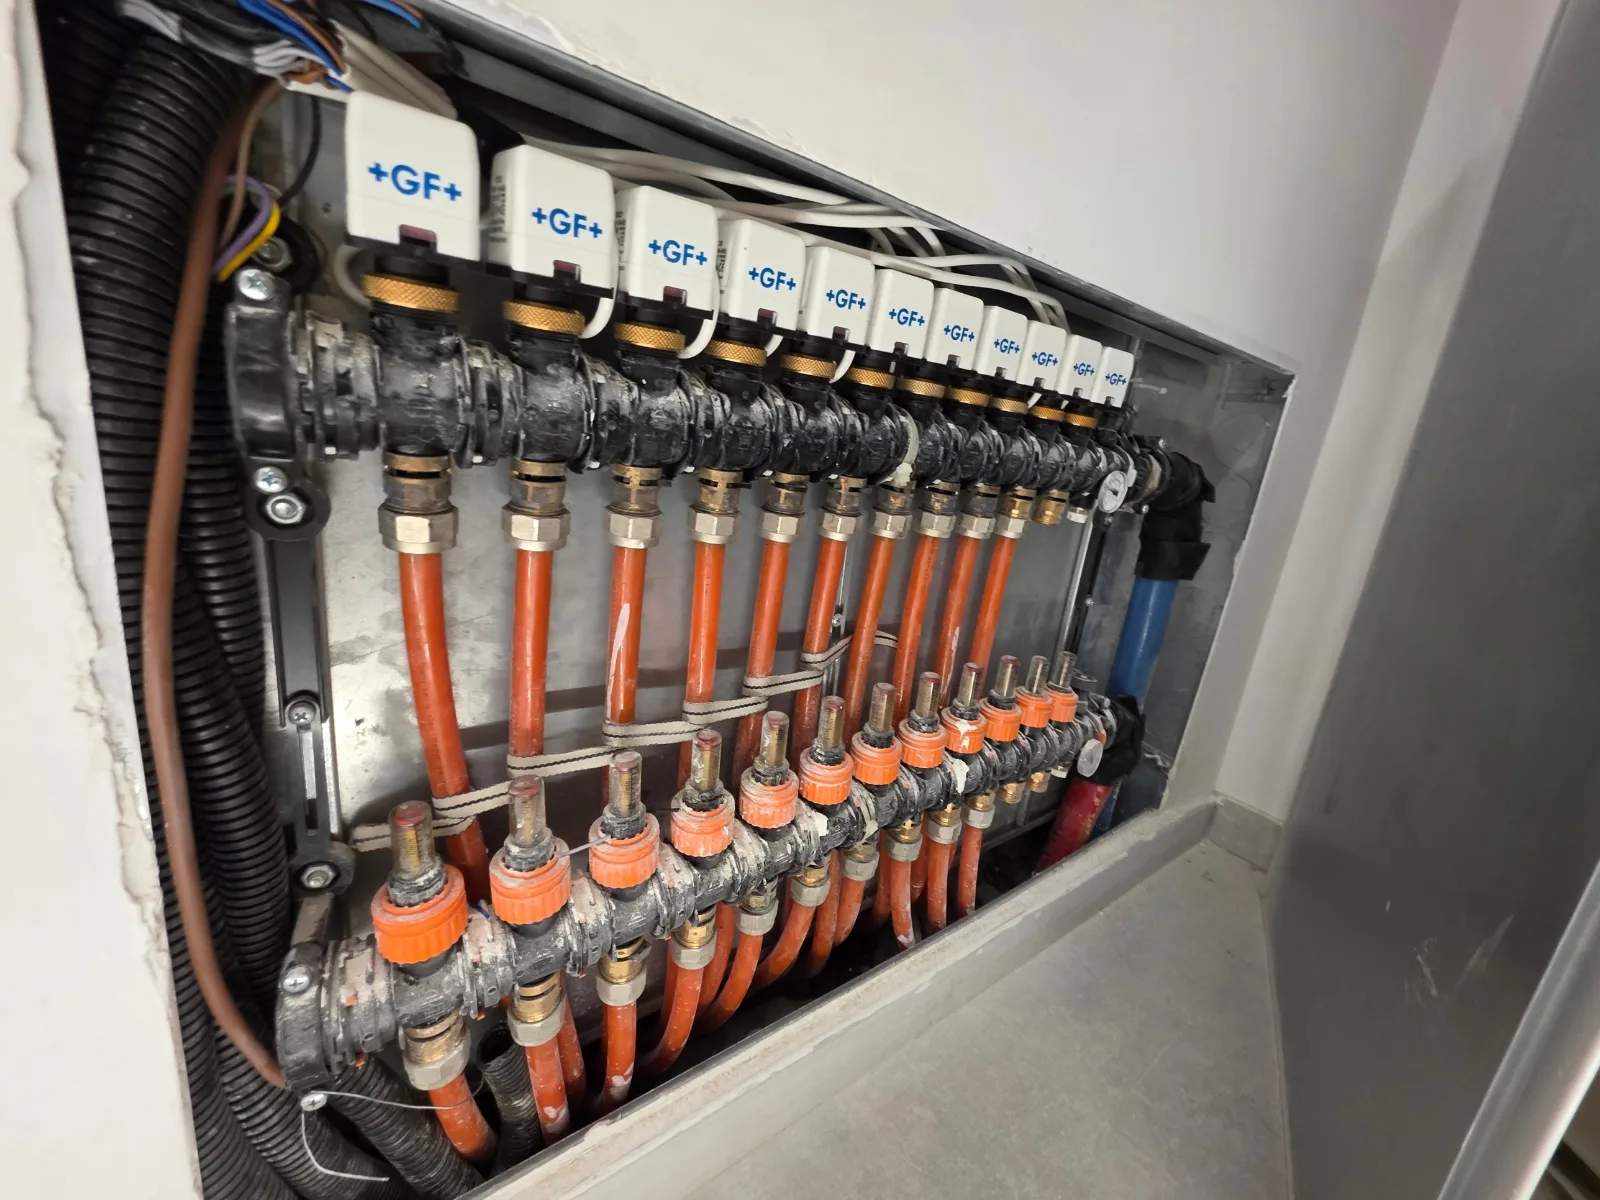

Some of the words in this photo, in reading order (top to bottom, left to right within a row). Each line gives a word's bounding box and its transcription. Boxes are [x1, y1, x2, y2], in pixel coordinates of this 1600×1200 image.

[368, 163, 461, 201] +GF+
[532, 208, 602, 238] +GF+
[648, 240, 708, 266] +GF+
[749, 267, 796, 291] +GF+
[826, 289, 866, 309] +GF+
[889, 308, 925, 326] +GF+
[944, 325, 975, 341] +GF+
[994, 338, 1020, 354] +GF+
